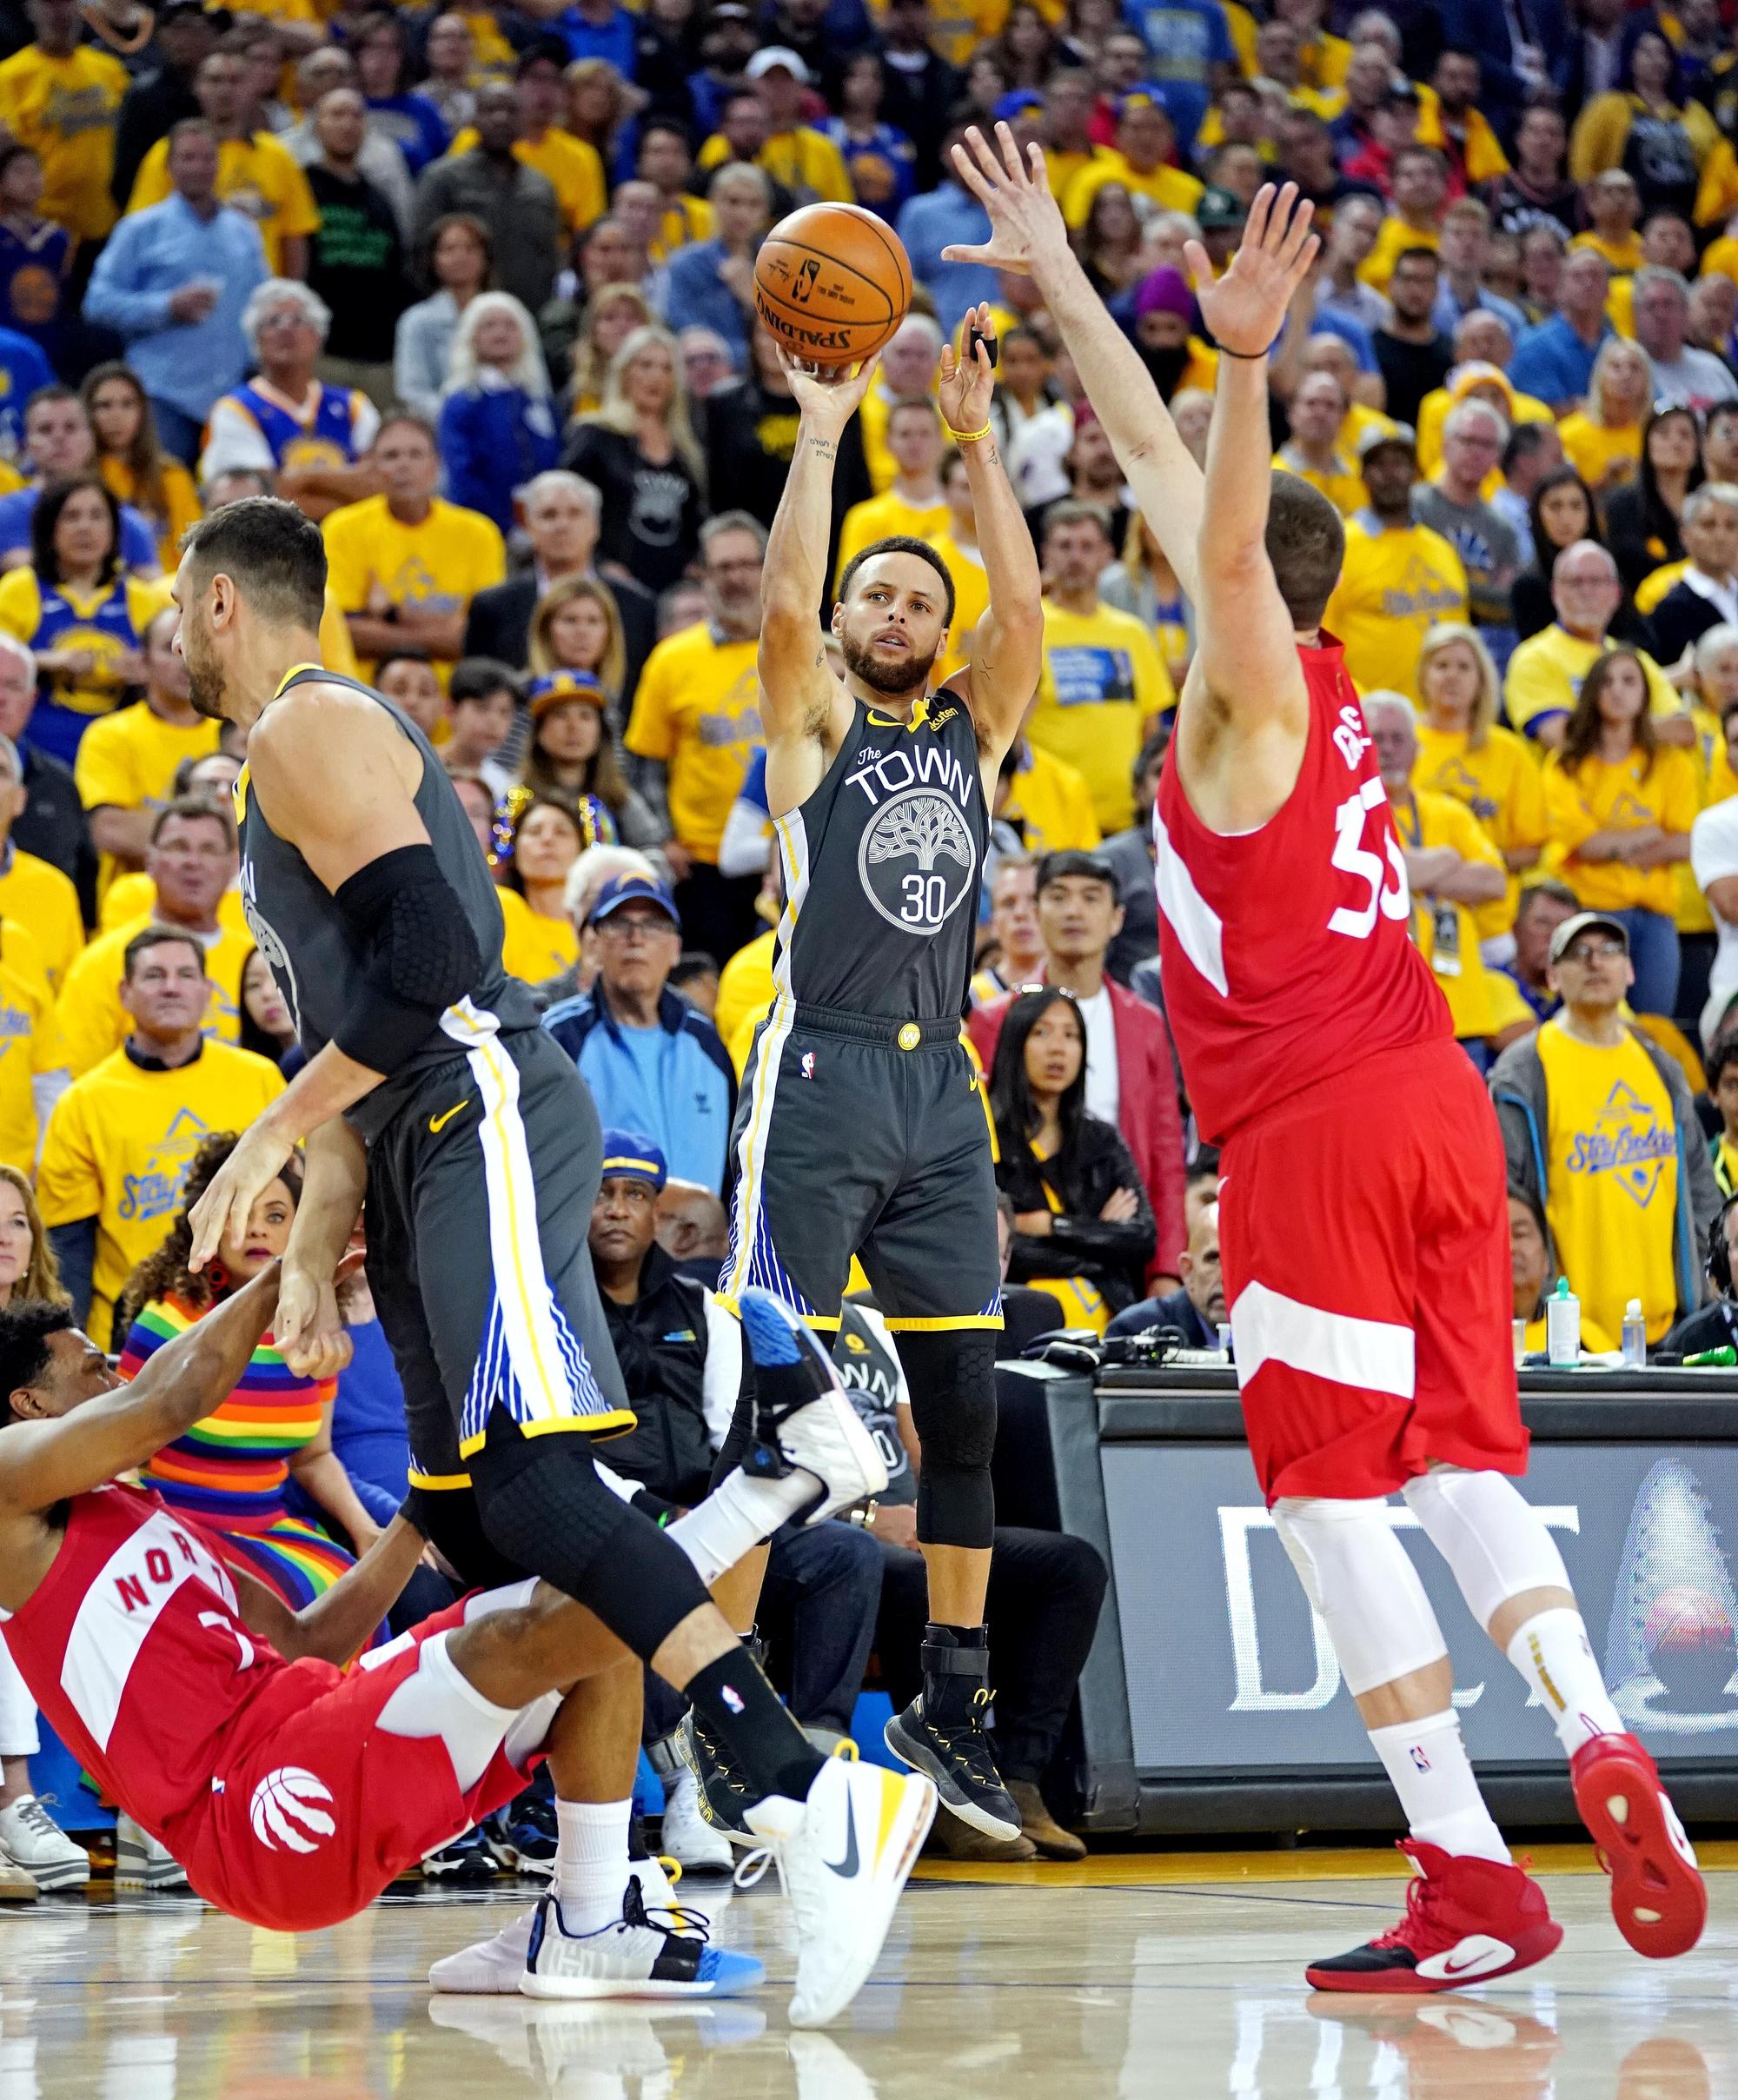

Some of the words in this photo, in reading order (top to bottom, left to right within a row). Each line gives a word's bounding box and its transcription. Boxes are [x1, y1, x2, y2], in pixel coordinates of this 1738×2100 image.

[756, 285, 852, 349] SPALDING
[929, 708, 959, 730] kuten
[844, 744, 974, 808] TOWN
[857, 746, 882, 765] The
[900, 874, 946, 924] 30
